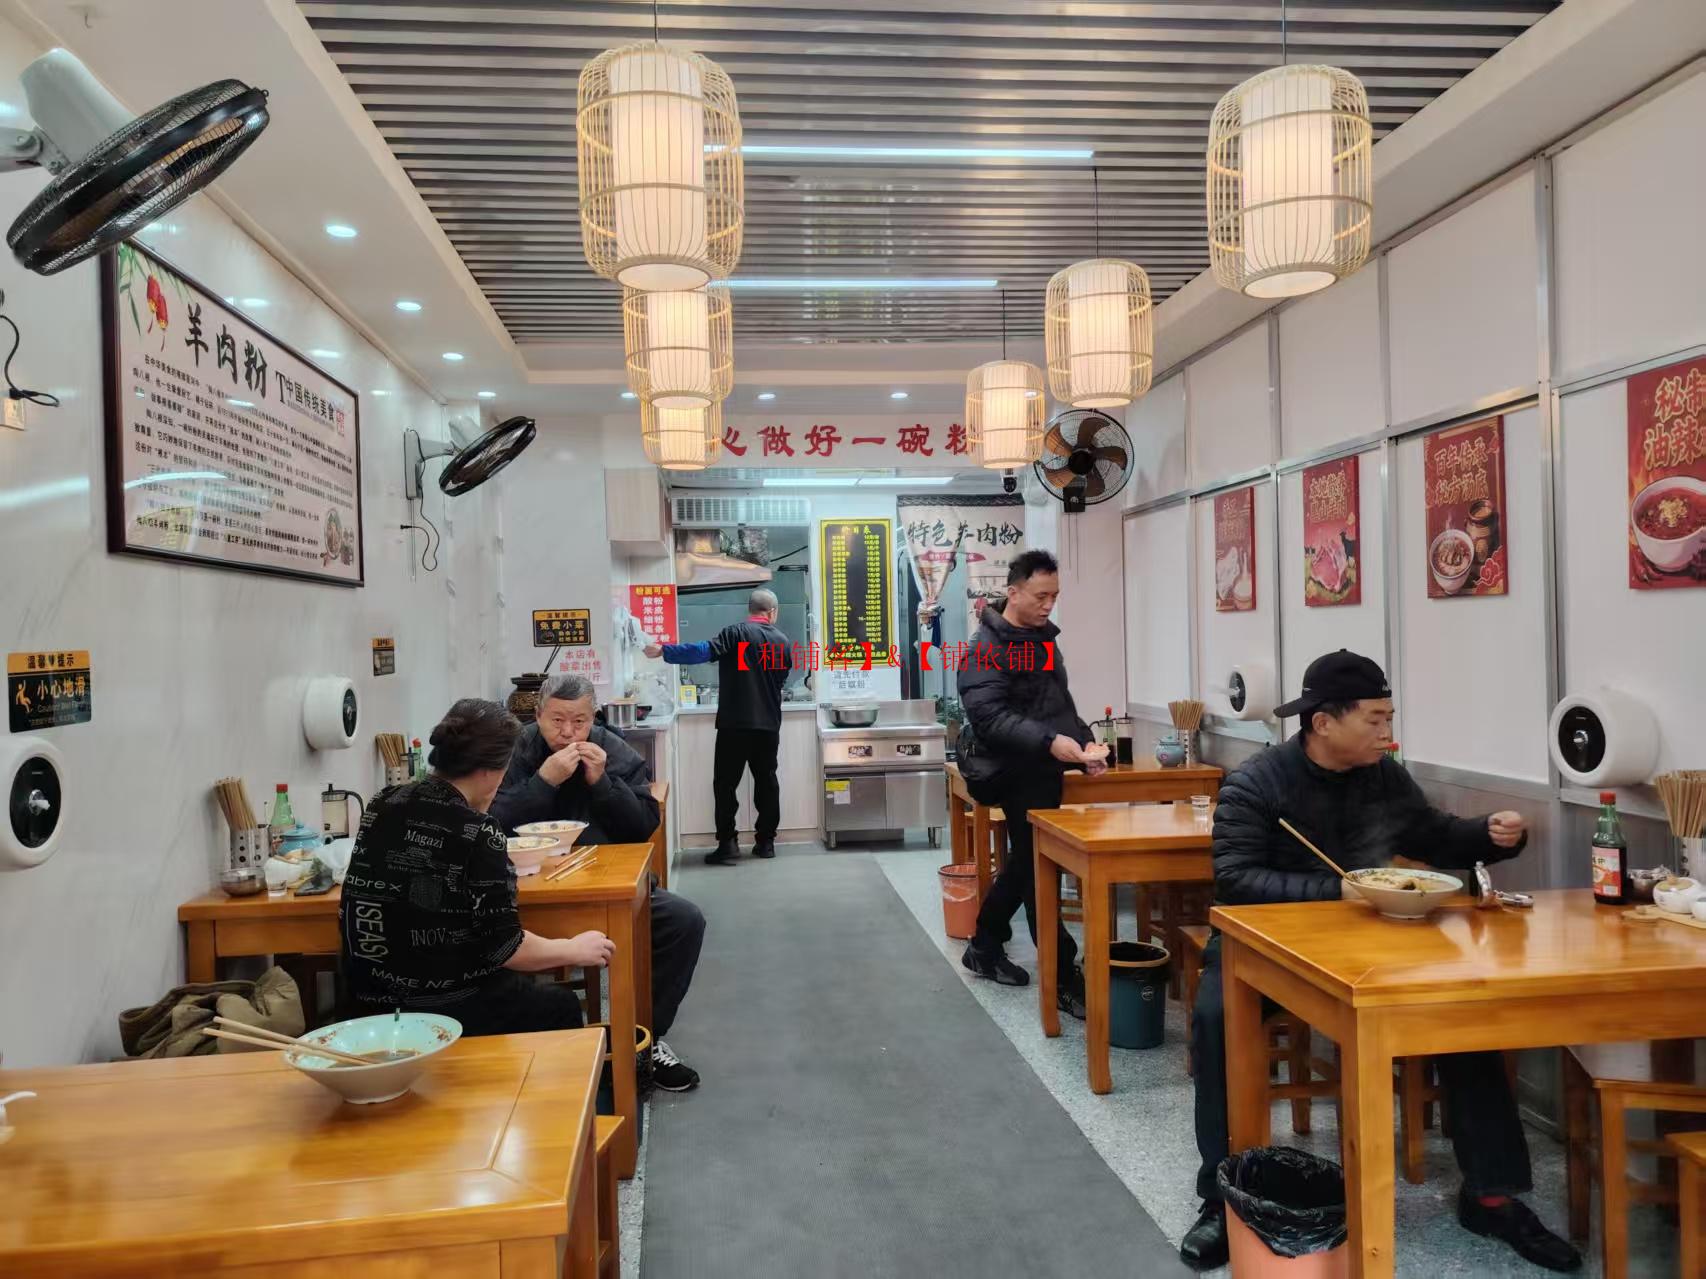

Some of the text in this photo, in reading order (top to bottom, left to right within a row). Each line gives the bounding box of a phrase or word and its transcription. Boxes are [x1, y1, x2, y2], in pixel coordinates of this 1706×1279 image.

[185, 303, 267, 399] 羊肉粉
[286, 375, 335, 422] 中国传统美食
[908, 520, 1023, 547] 特色羊肉粉
[37, 676, 85, 701] 小心地滑
[371, 968, 420, 988] MAKE
